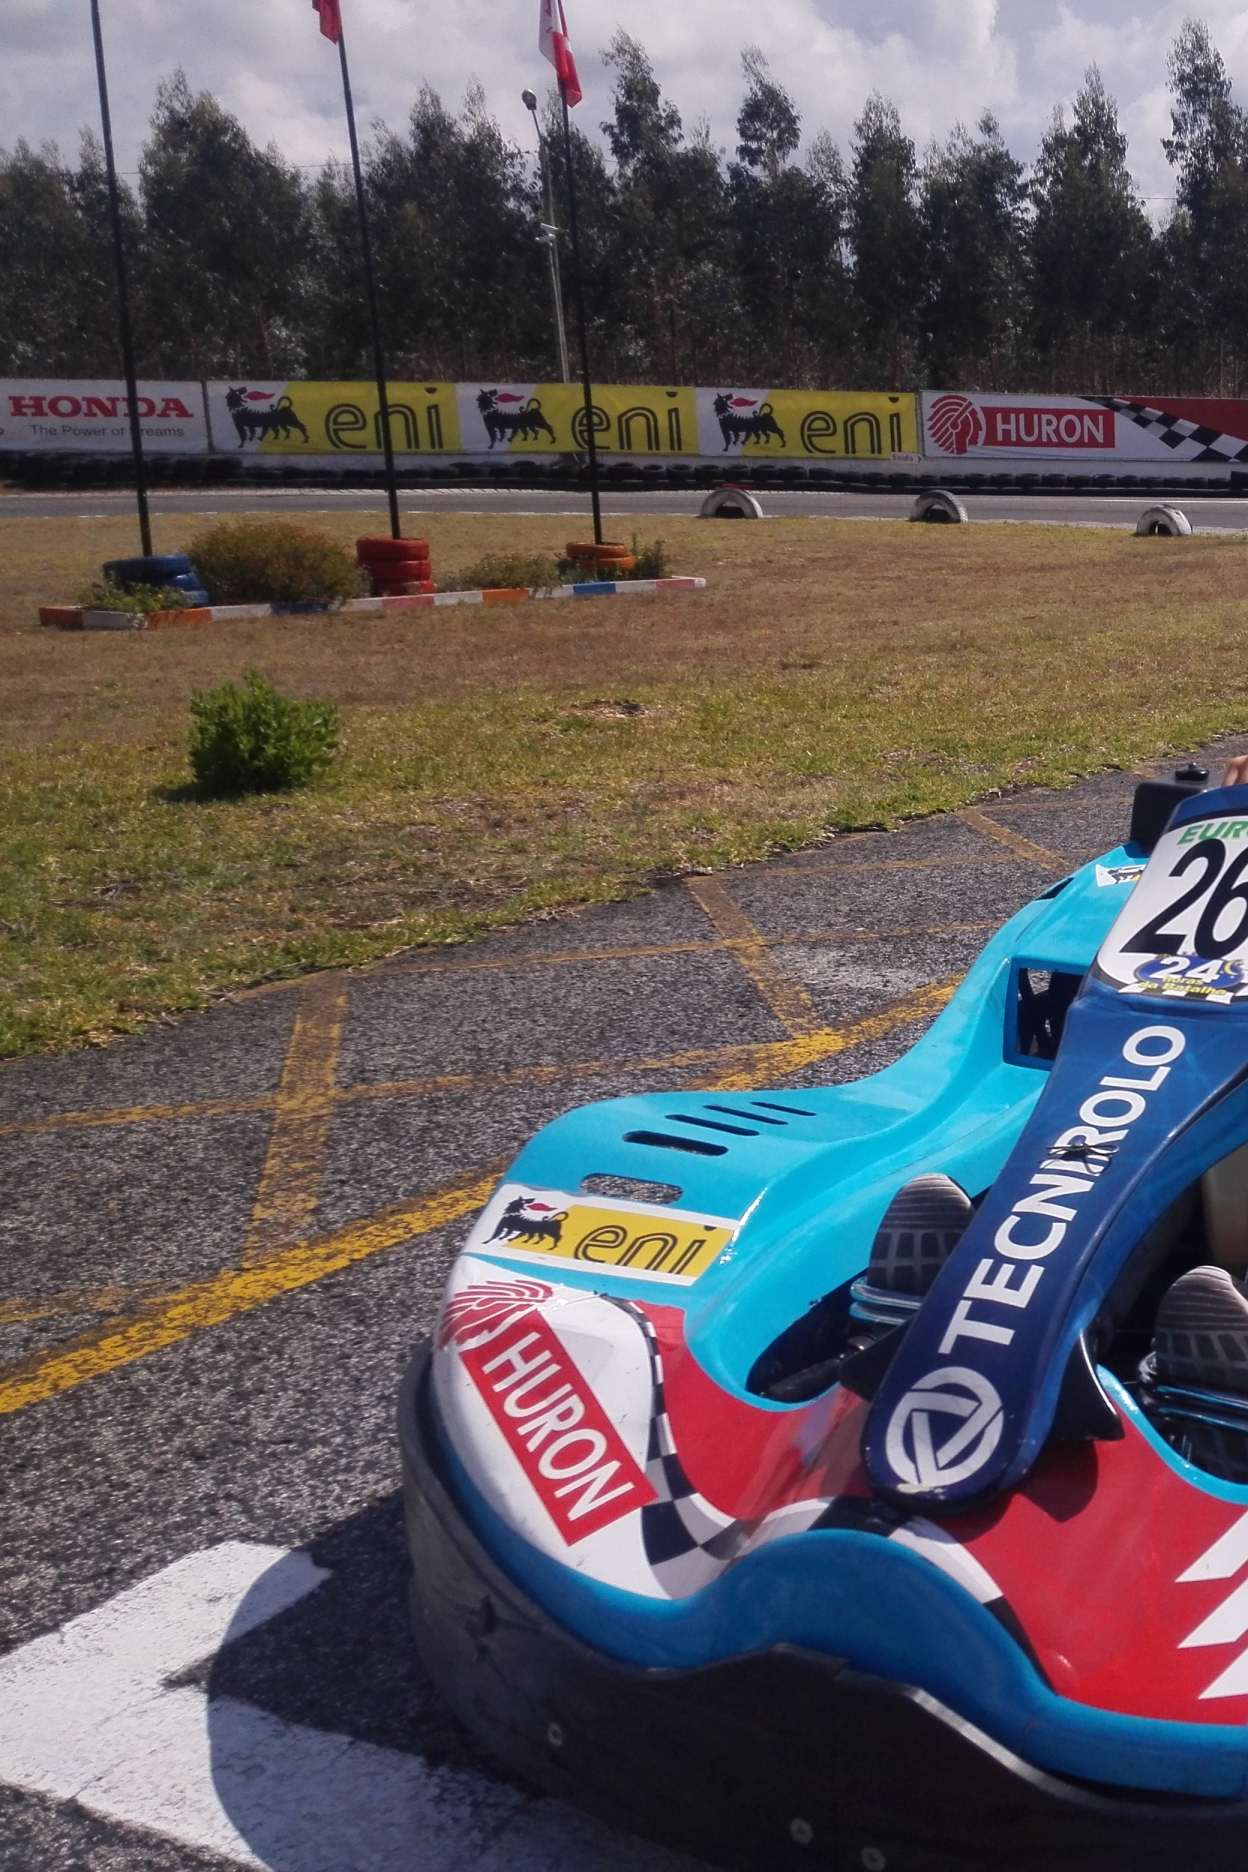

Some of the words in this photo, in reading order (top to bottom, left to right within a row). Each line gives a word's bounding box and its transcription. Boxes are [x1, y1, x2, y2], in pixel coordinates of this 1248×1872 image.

[8, 395, 194, 418] HONDA
[31, 424, 57, 437] The
[62, 425, 105, 437] Power
[112, 425, 125, 437] of
[137, 427, 185, 438] reams
[325, 387, 444, 450] eni
[572, 391, 682, 451] eni
[800, 397, 901, 454] eni
[995, 413, 1104, 443] HURON
[1149, 956, 1225, 983] 24
[938, 1025, 1186, 1354] TECNIROLO
[574, 1224, 718, 1275] eni
[483, 1331, 635, 1521] HURON
